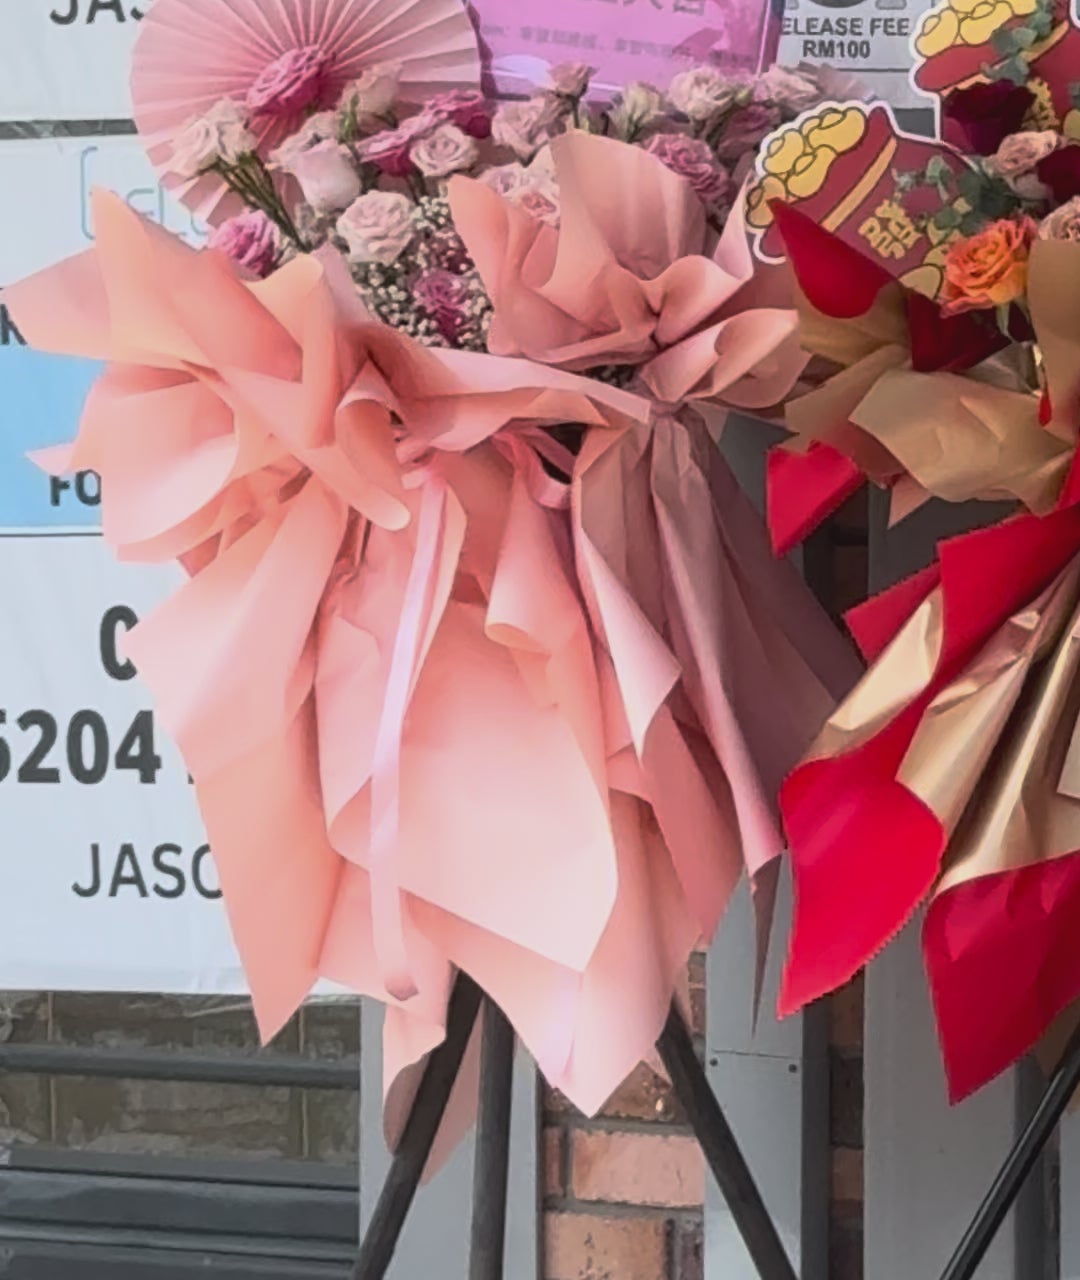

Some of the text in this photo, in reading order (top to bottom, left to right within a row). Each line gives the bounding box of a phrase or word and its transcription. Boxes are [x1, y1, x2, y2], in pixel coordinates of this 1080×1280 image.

[780, 16, 911, 38] ELEASE FEE
[802, 39, 872, 60] RM100
